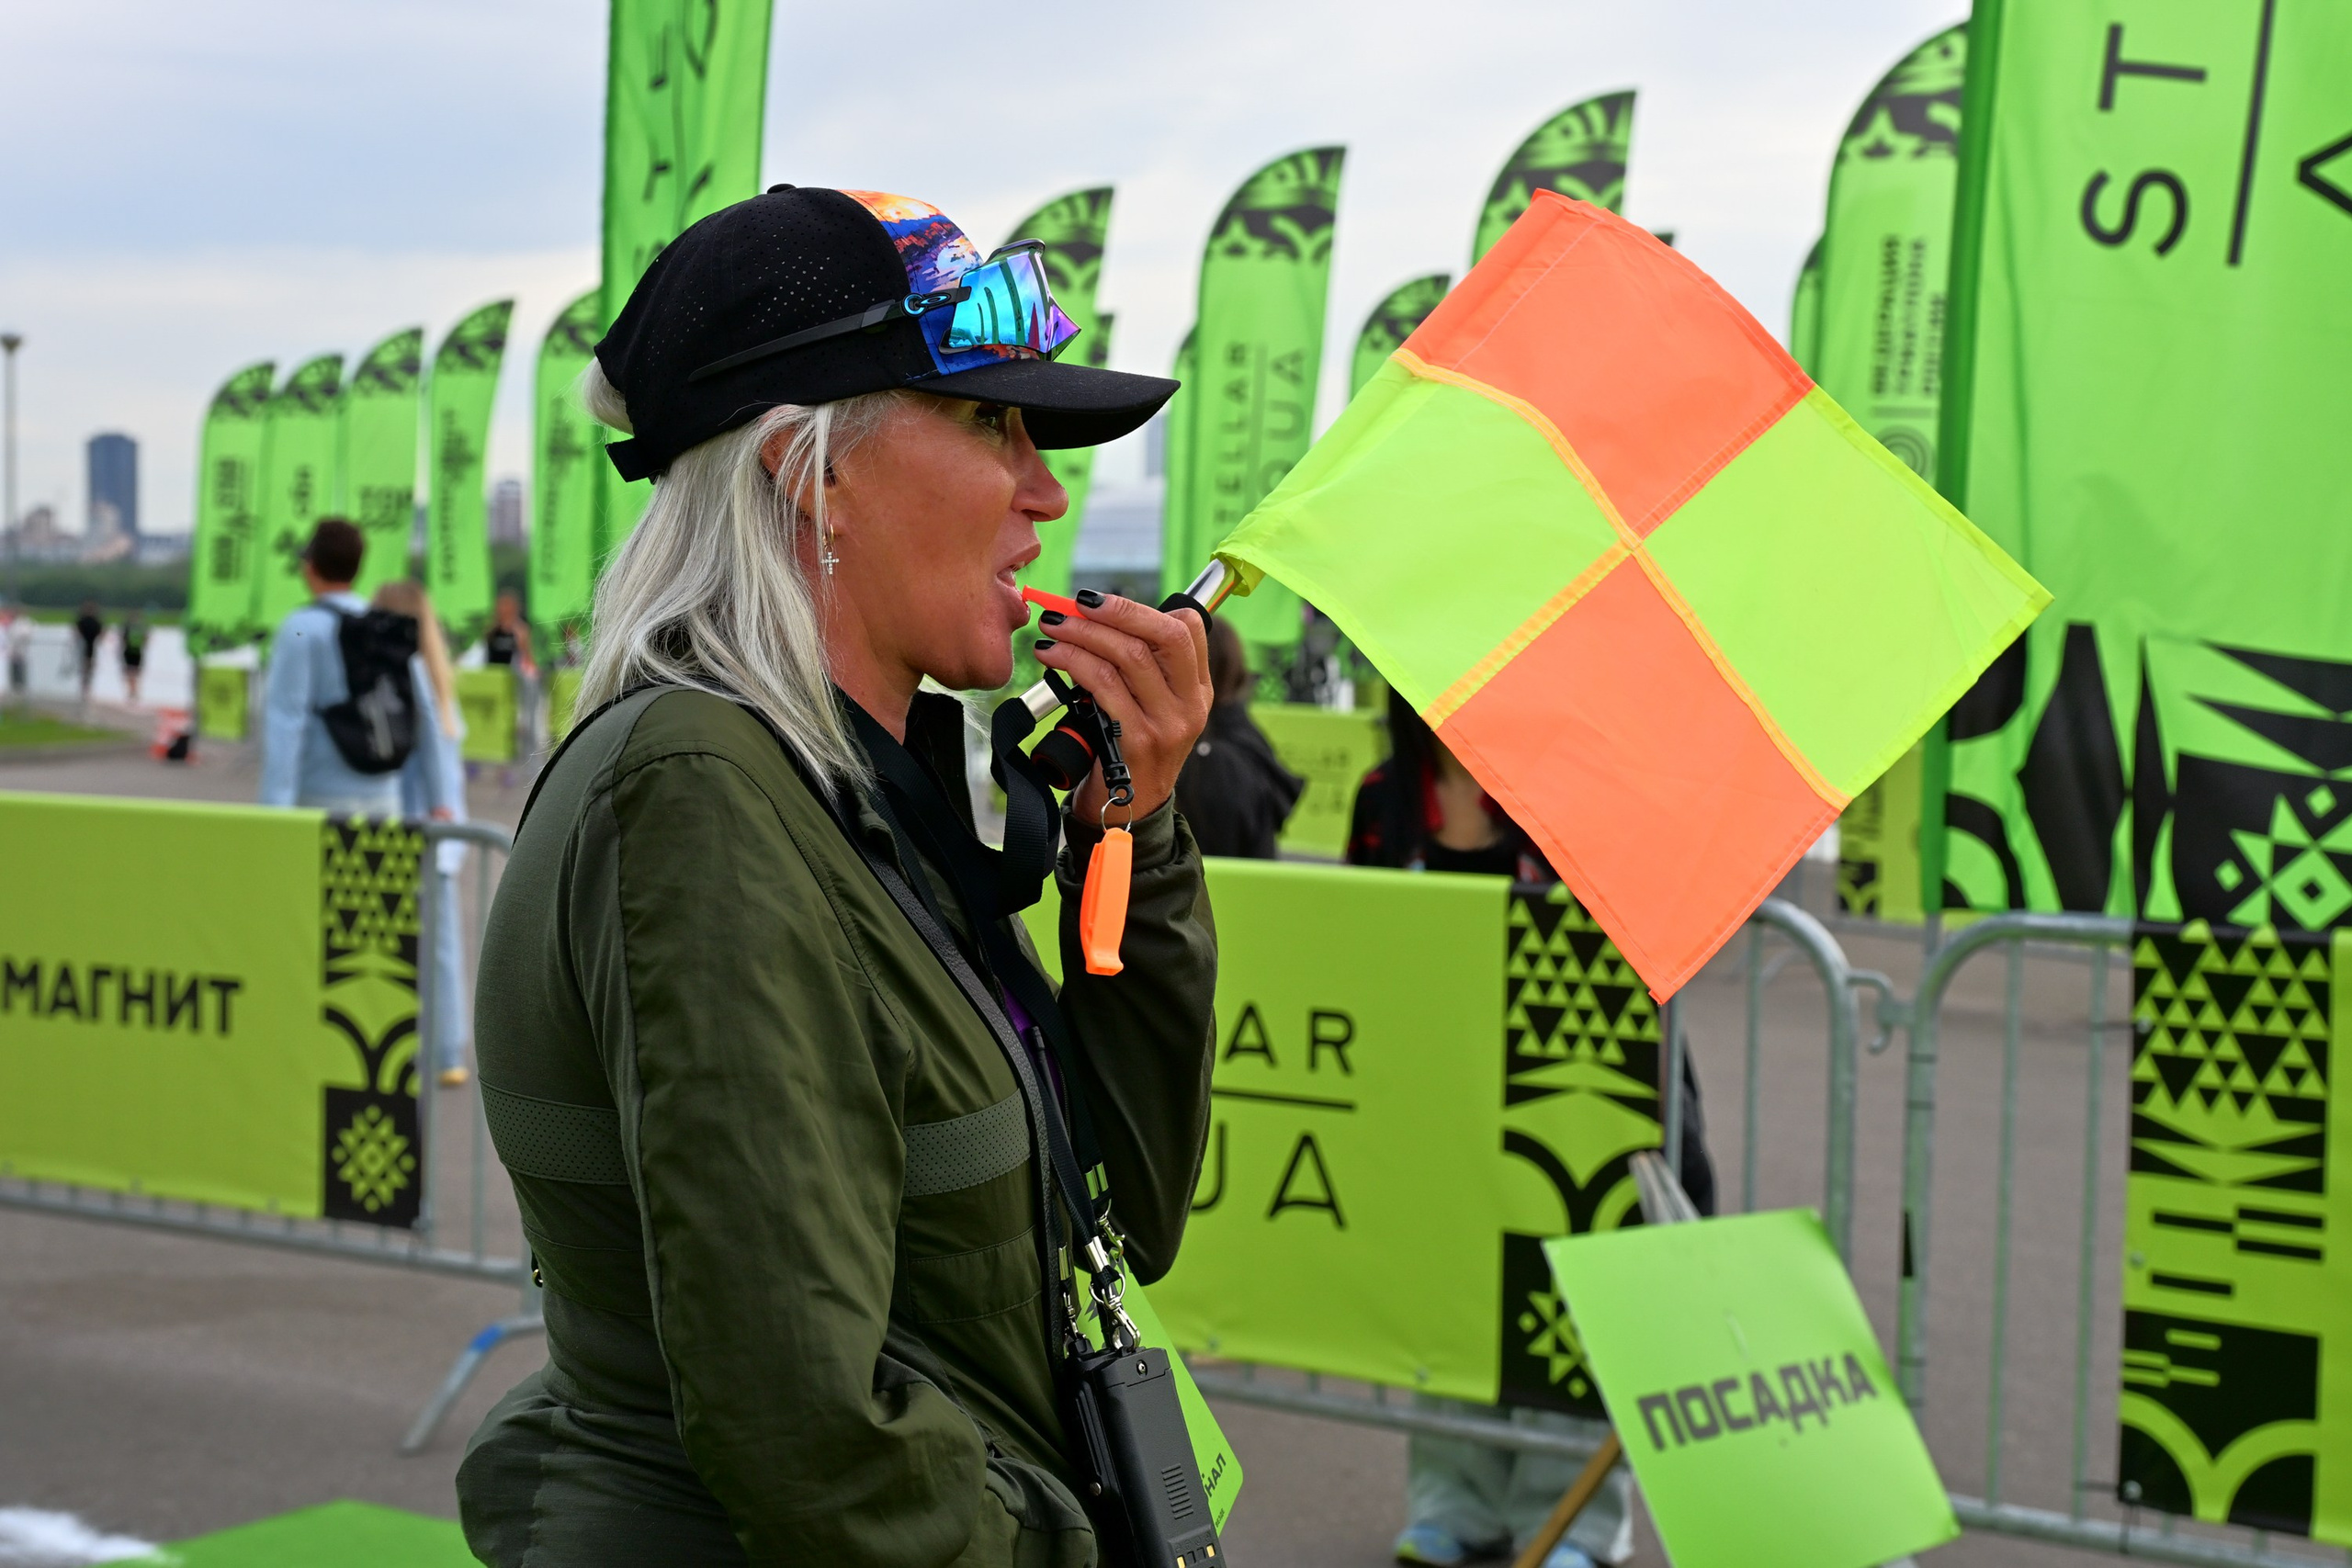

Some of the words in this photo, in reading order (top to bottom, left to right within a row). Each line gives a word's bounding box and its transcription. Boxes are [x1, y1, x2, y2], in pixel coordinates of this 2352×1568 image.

[1213, 340, 1248, 551] TELLAR
[0, 955, 243, 1038] МАГНИТ
[1635, 1352, 1878, 1453] ПОСАДКА
